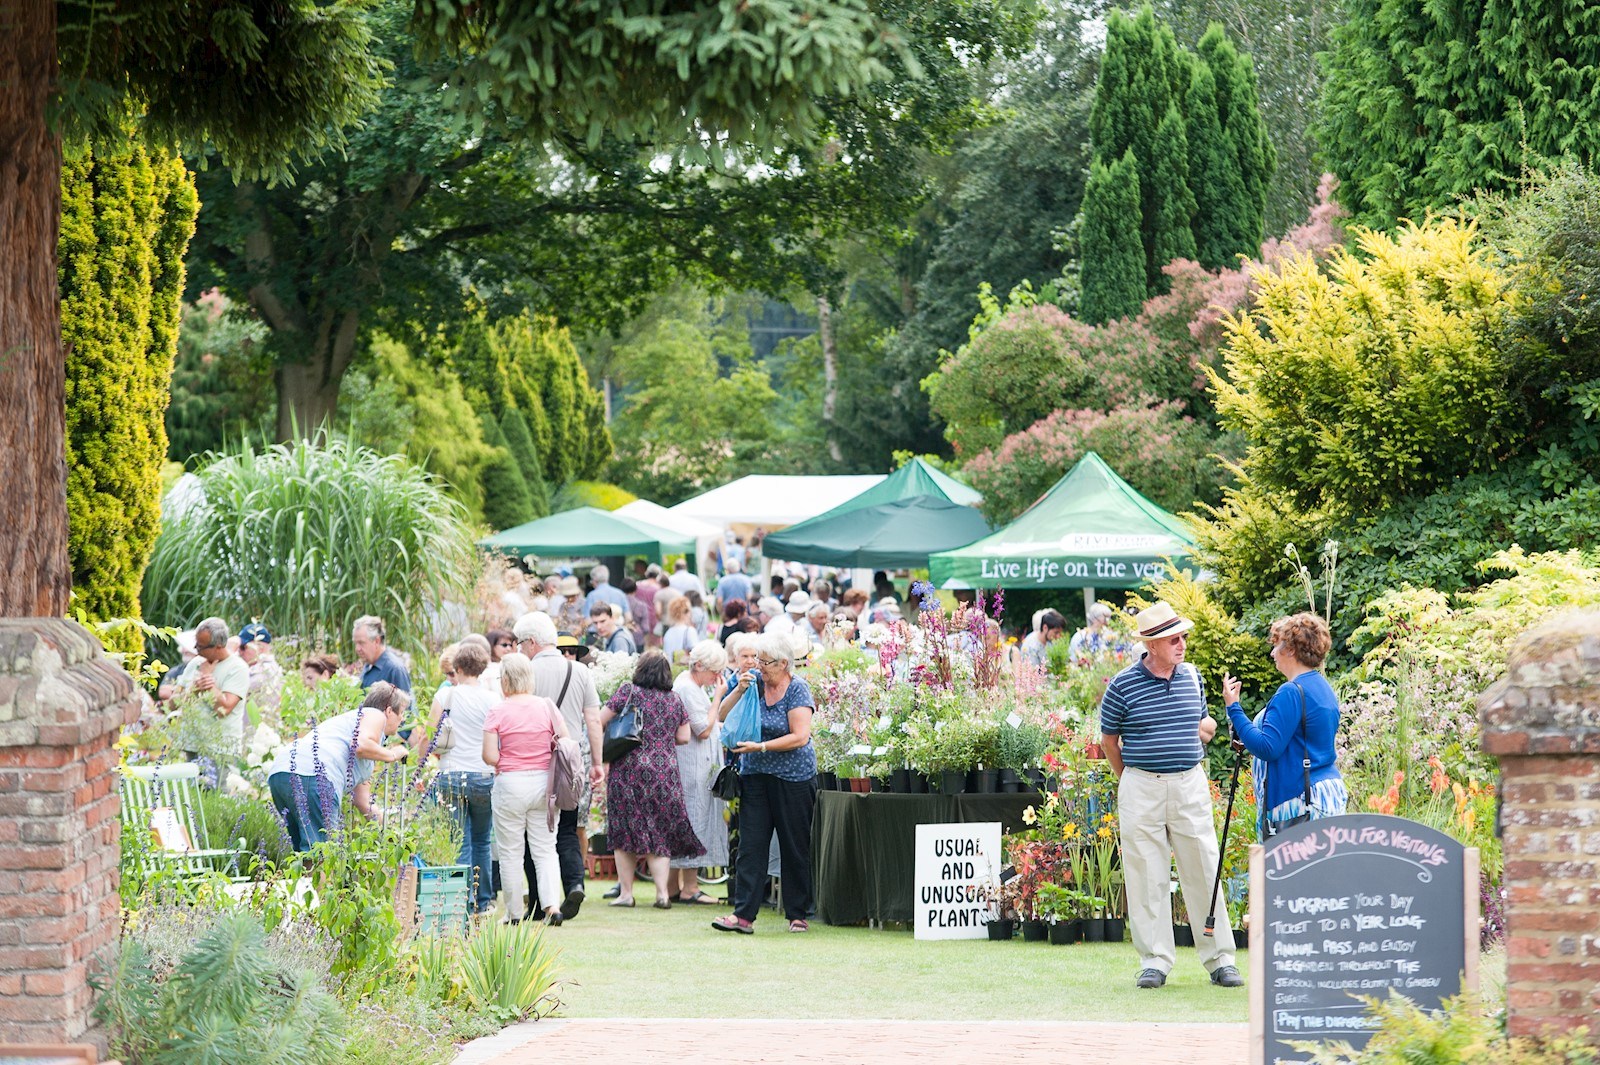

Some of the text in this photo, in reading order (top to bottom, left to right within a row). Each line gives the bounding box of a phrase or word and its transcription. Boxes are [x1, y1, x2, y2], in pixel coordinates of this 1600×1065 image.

[981, 559, 1020, 578] Live
[1026, 558, 1058, 583] life
[1064, 560, 1089, 577] on
[1095, 558, 1126, 578] the
[935, 838, 984, 857] USUAL
[1265, 832, 1327, 870] THANK
[1322, 826, 1359, 857] YOU
[1359, 826, 1390, 846] FOR
[941, 862, 974, 880] AND
[921, 885, 998, 904] UNUSUA
[1287, 893, 1414, 915] UPGRADE YOUR DAY
[1269, 914, 1427, 934] TICKET TO A YEAR LONG
[1273, 940, 1320, 958] ANNUAL
[1358, 942, 1379, 953] AND
[1380, 939, 1417, 953] ENJOY
[1393, 959, 1422, 974] THE
[1391, 978, 1404, 987] TO
[1405, 977, 1442, 988] GARDEN
[1277, 1012, 1301, 1030] PAY
[1301, 1016, 1325, 1028] THE
